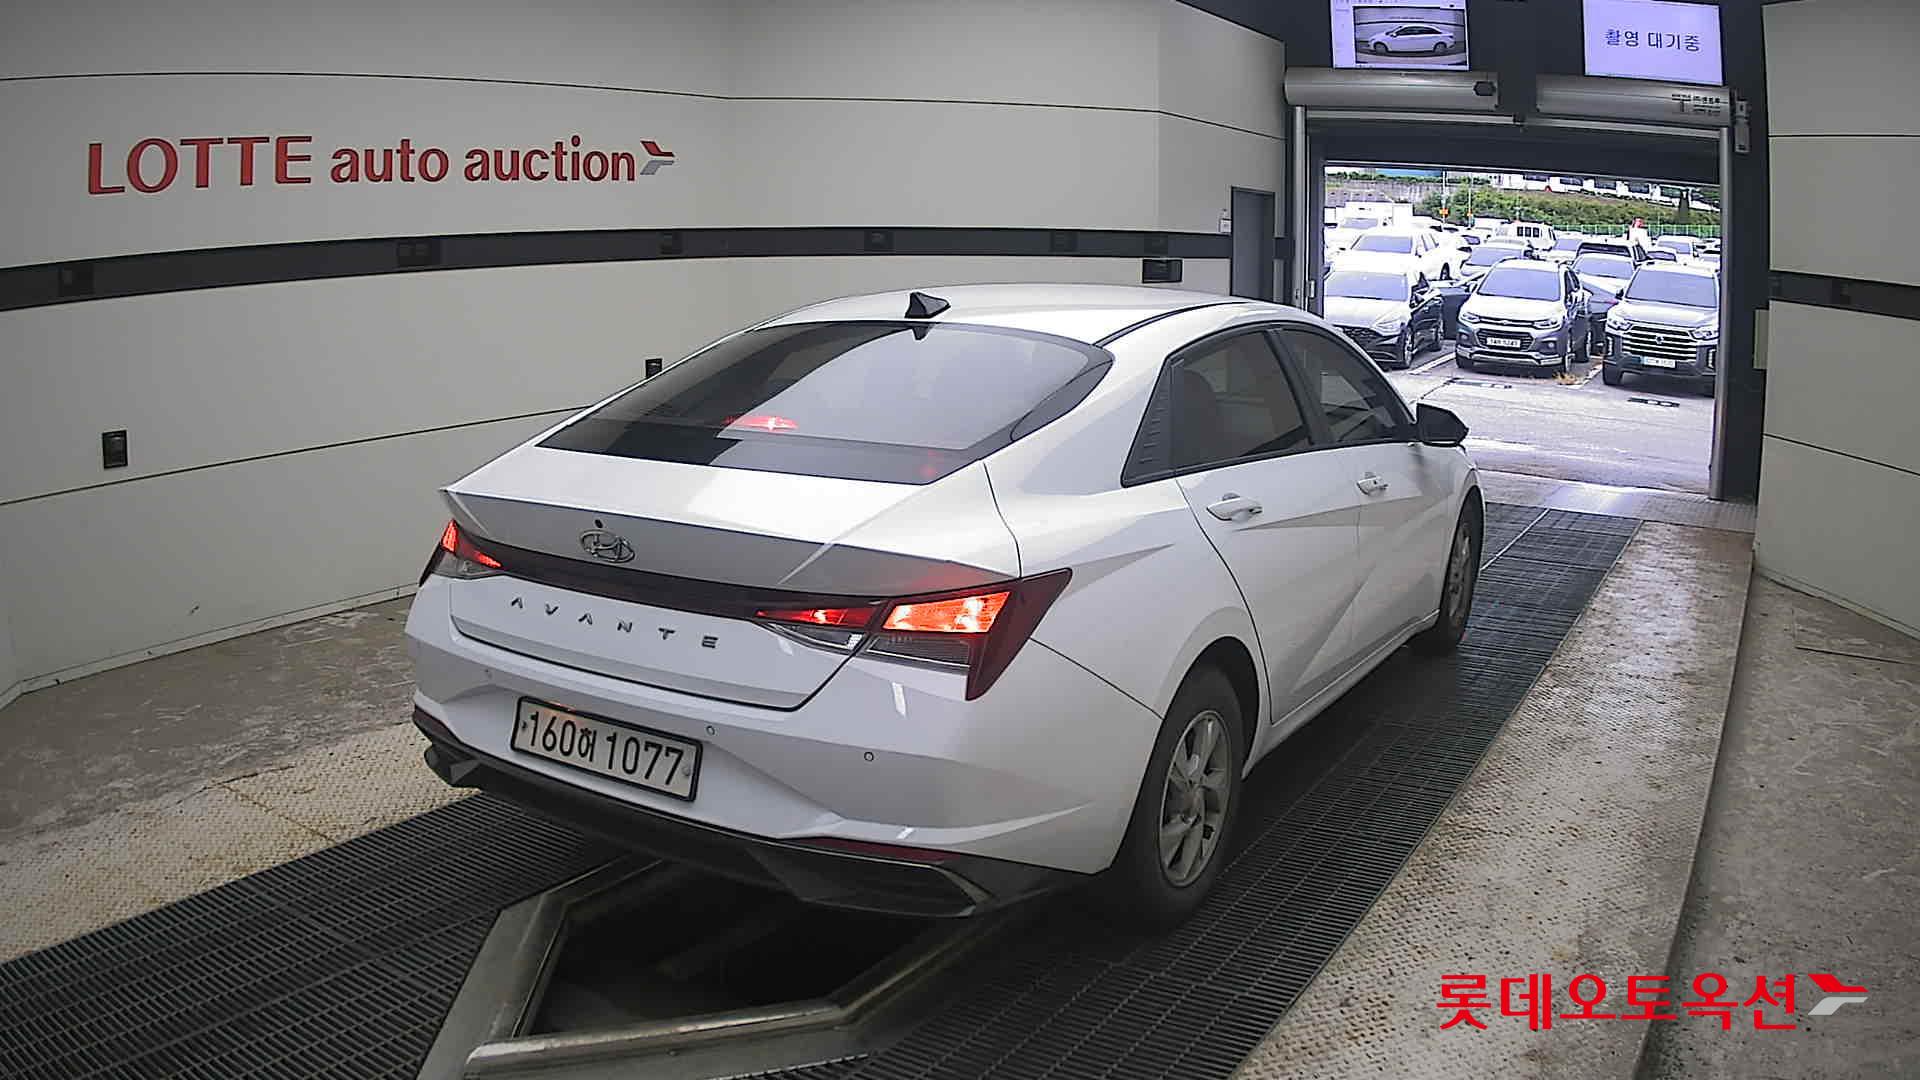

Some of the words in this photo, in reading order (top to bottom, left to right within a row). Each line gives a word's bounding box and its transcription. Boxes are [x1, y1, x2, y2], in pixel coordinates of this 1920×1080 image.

[1648, 31, 1700, 52] 대기중
[88, 136, 312, 195] LOTTE
[331, 139, 449, 184] auto
[464, 135, 636, 183] auction
[511, 597, 719, 649] AVANTE
